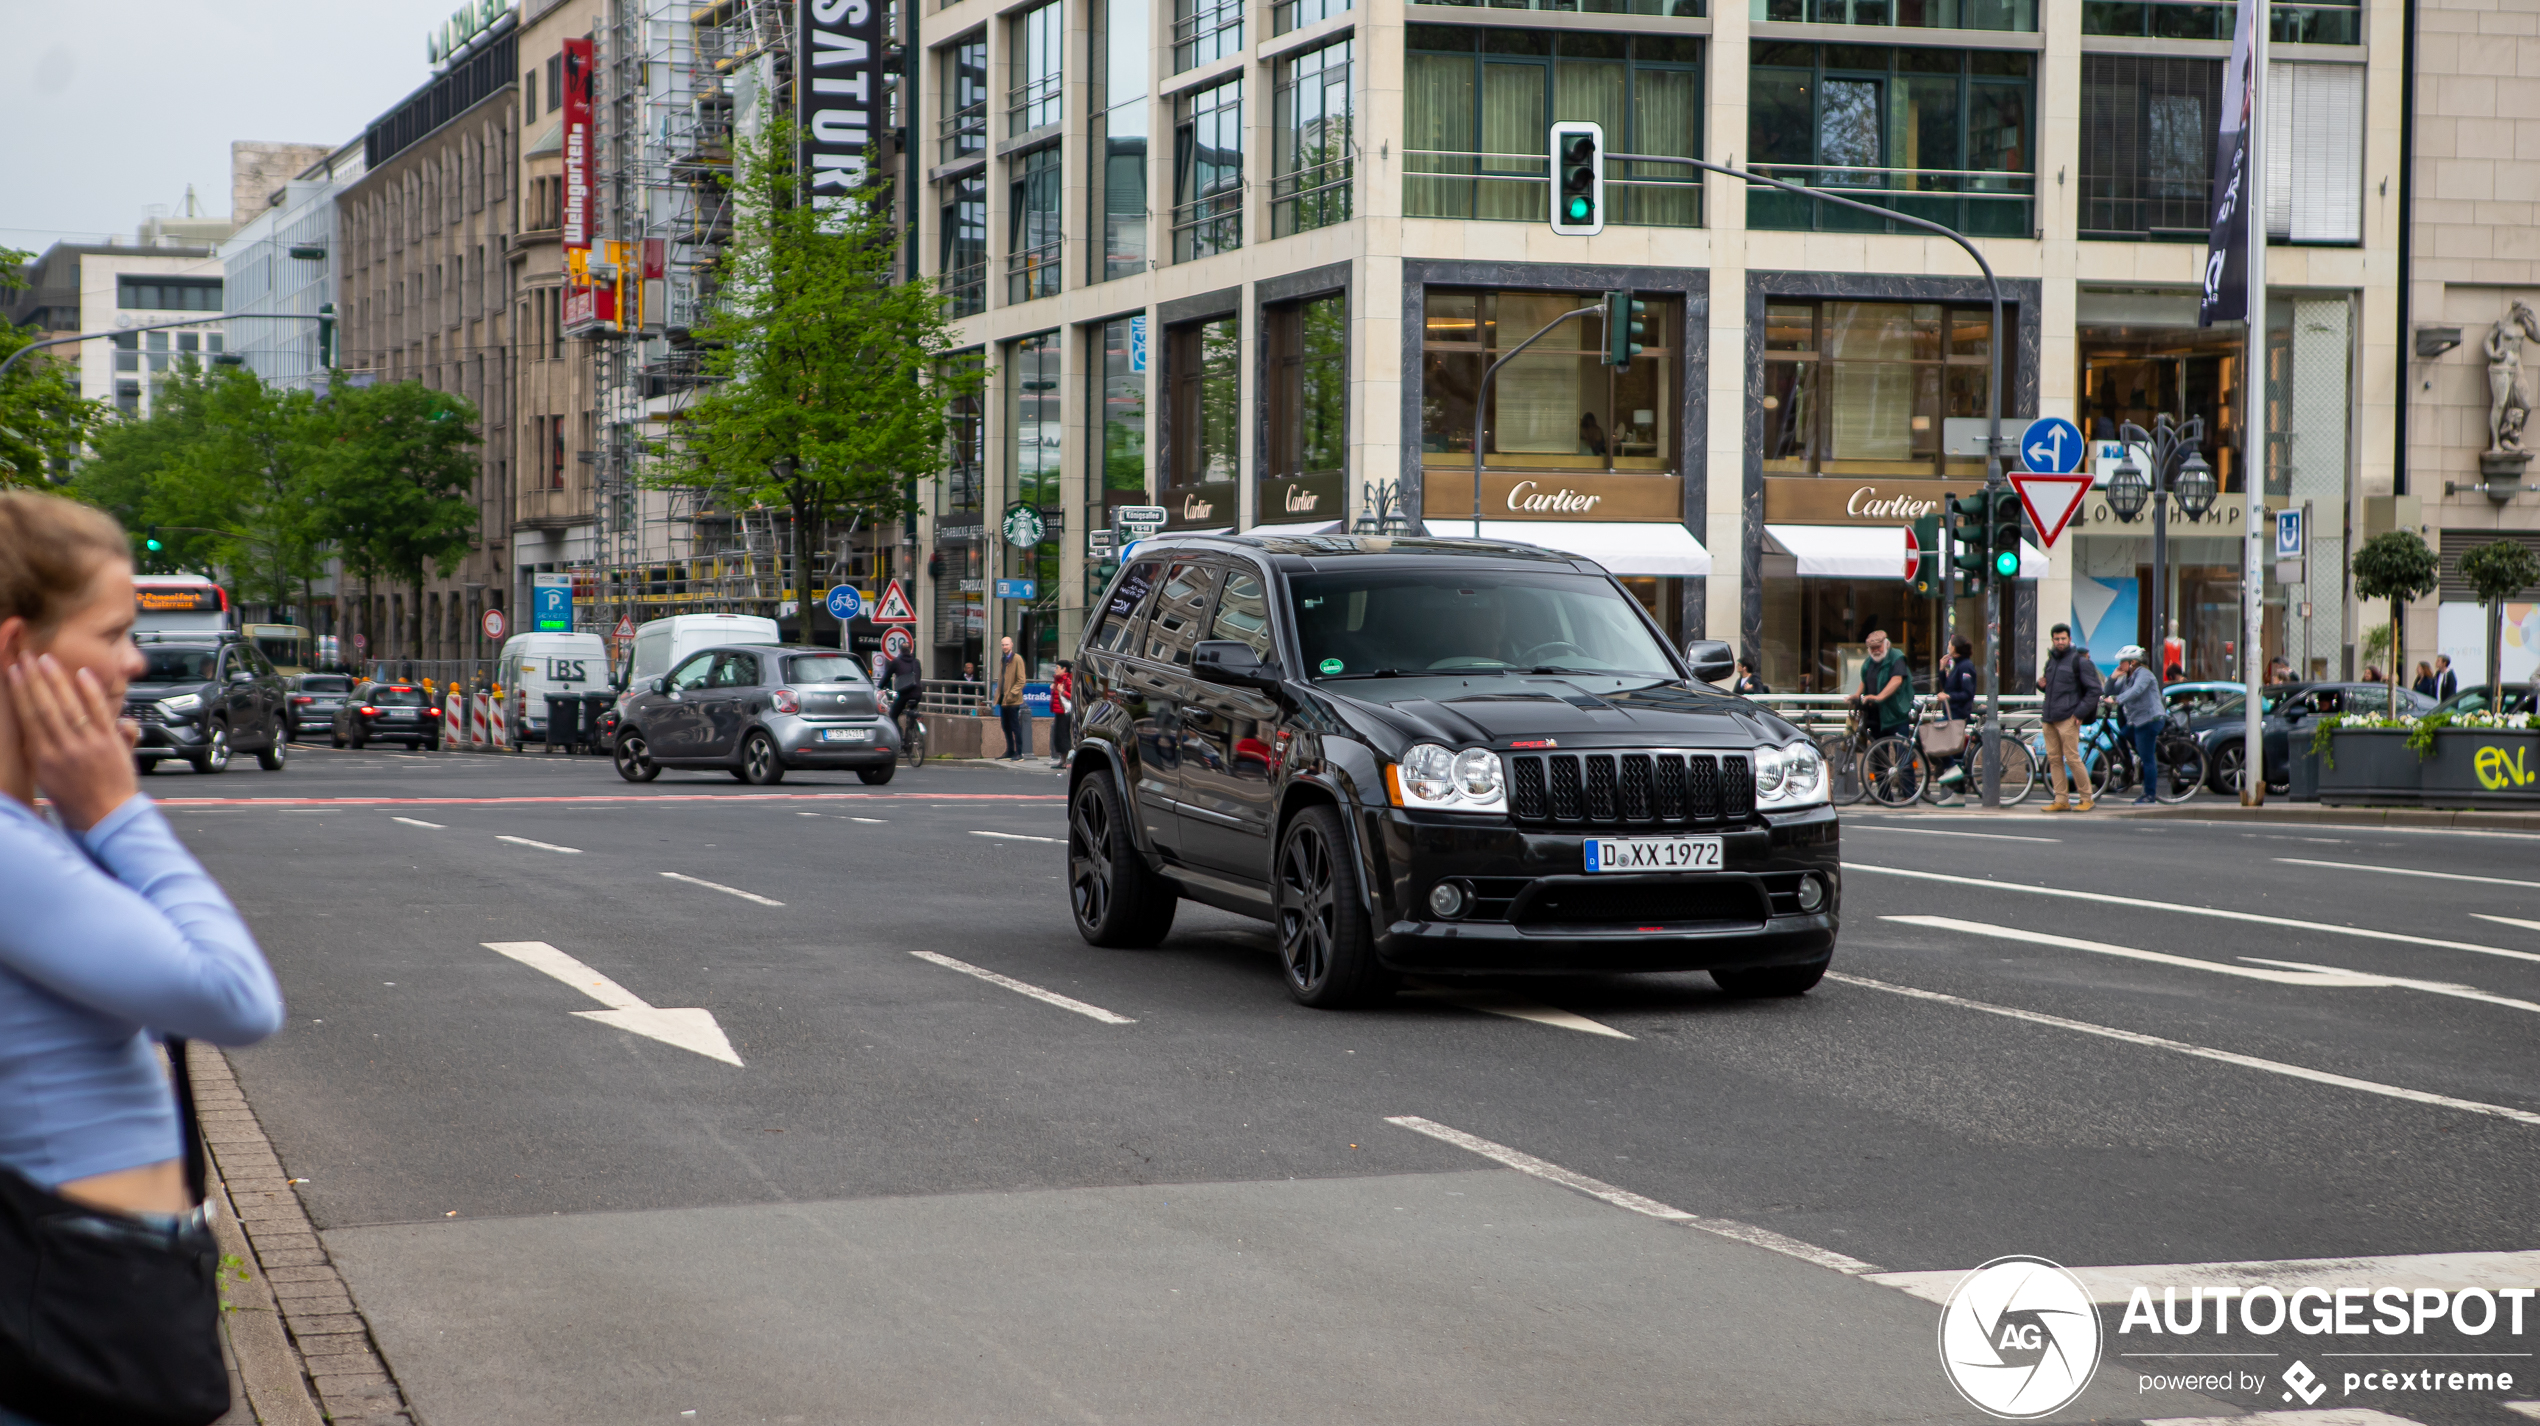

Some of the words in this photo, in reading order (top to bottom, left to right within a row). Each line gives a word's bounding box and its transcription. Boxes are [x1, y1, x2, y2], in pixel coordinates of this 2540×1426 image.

[1184, 493, 1213, 520] Cartier
[1286, 484, 1318, 512] Cartier
[1507, 480, 1601, 512] Cartier
[1846, 486, 1937, 518] Cartier
[941, 525, 968, 538] STARBUCKS
[549, 594, 560, 610] P
[547, 656, 585, 681] LBS
[1022, 692, 1052, 701] straße
[1602, 844, 1616, 866] D
[1630, 843, 1659, 866] XX
[1665, 843, 1718, 865] 1972
